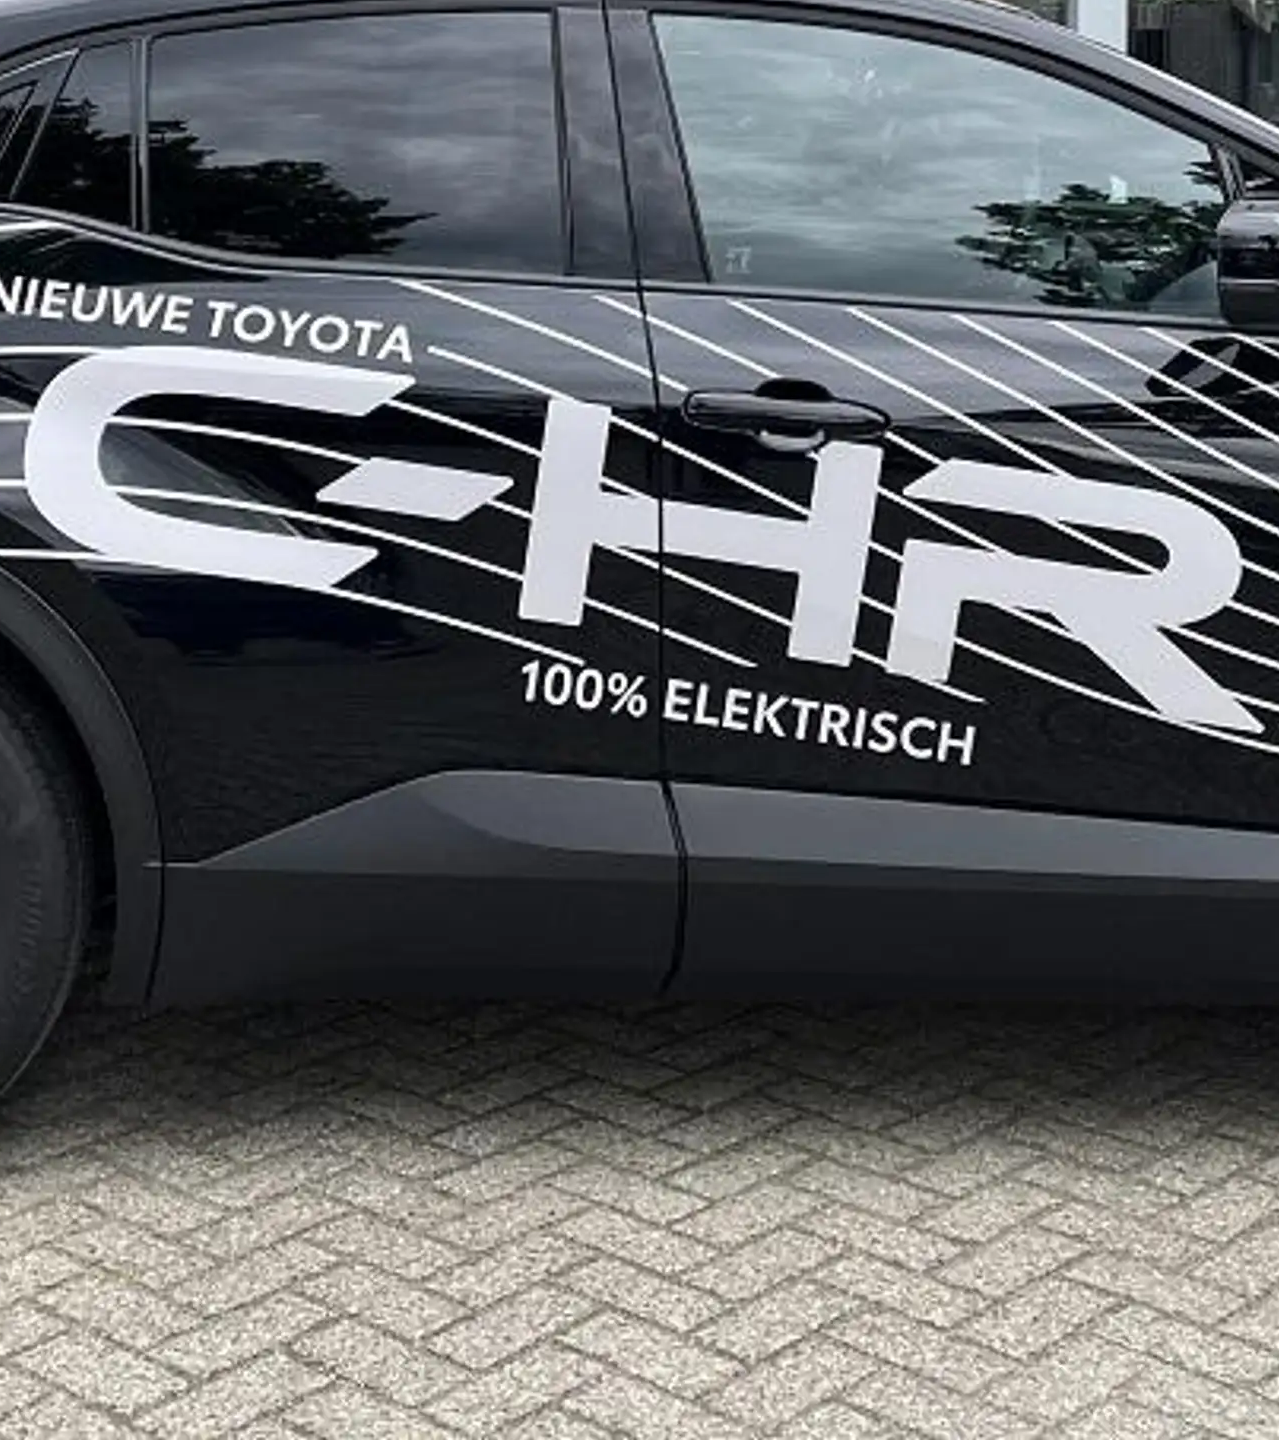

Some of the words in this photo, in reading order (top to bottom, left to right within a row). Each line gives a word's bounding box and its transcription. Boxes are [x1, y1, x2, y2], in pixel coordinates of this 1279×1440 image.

[205, 299, 414, 363] TOYOTA
[520, 660, 649, 718] 100%
[662, 678, 977, 766] ELEKTRISCH
